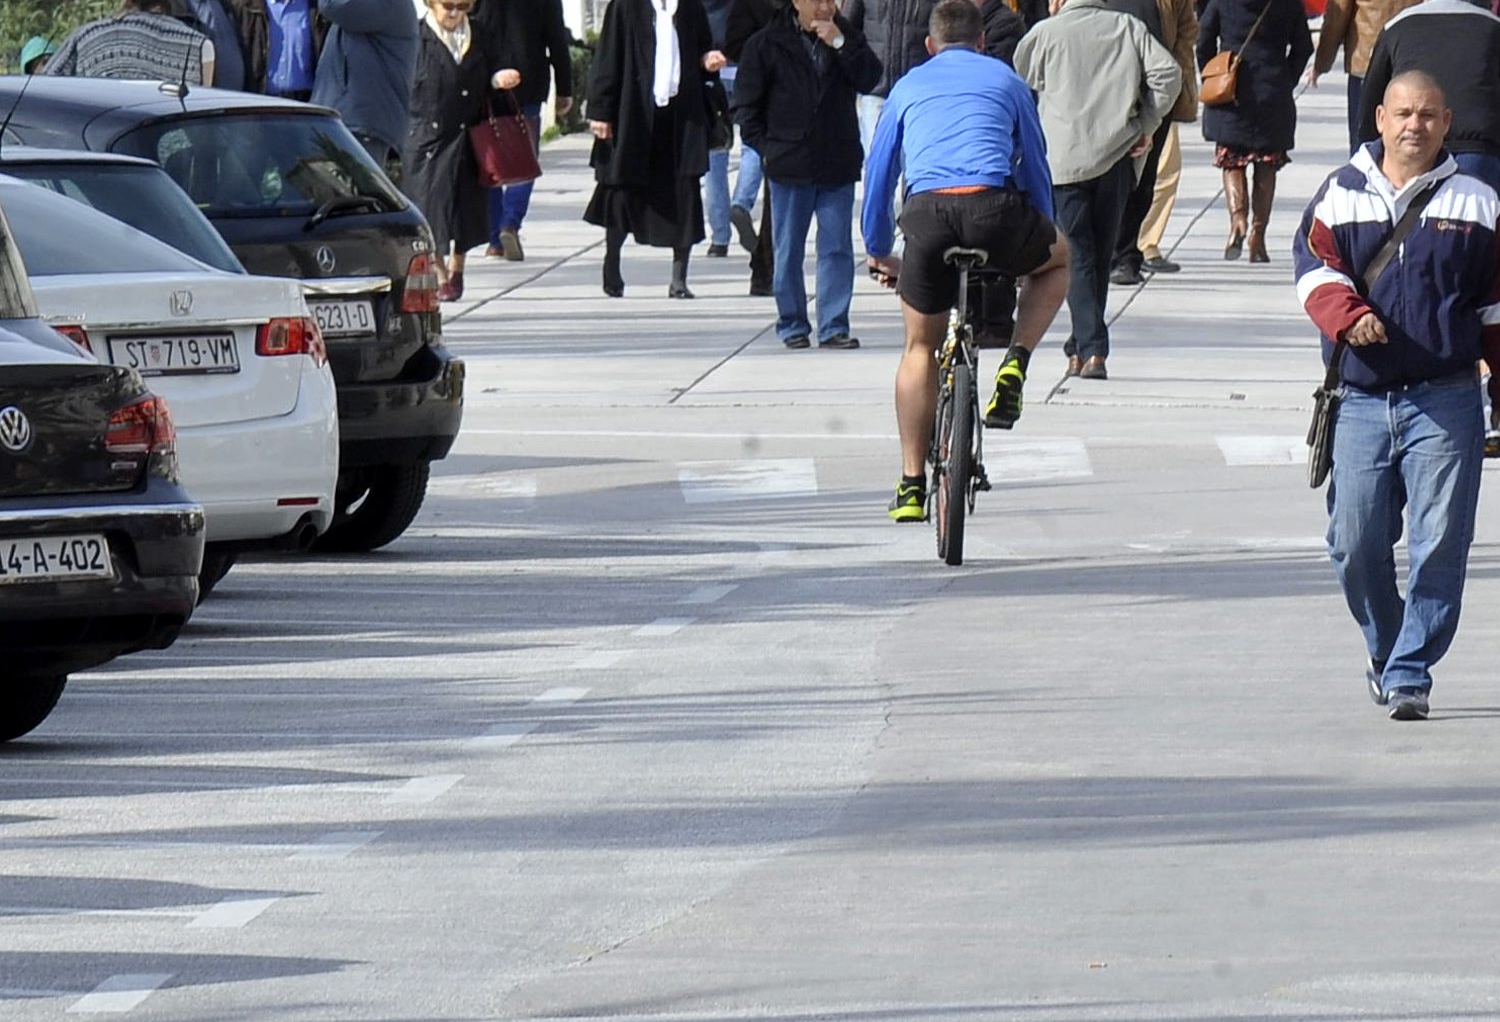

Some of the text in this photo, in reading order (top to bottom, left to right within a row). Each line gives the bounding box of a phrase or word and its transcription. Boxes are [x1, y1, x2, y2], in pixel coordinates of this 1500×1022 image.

[315, 304, 368, 330] 6231-D
[126, 338, 235, 368] ST 719-VM
